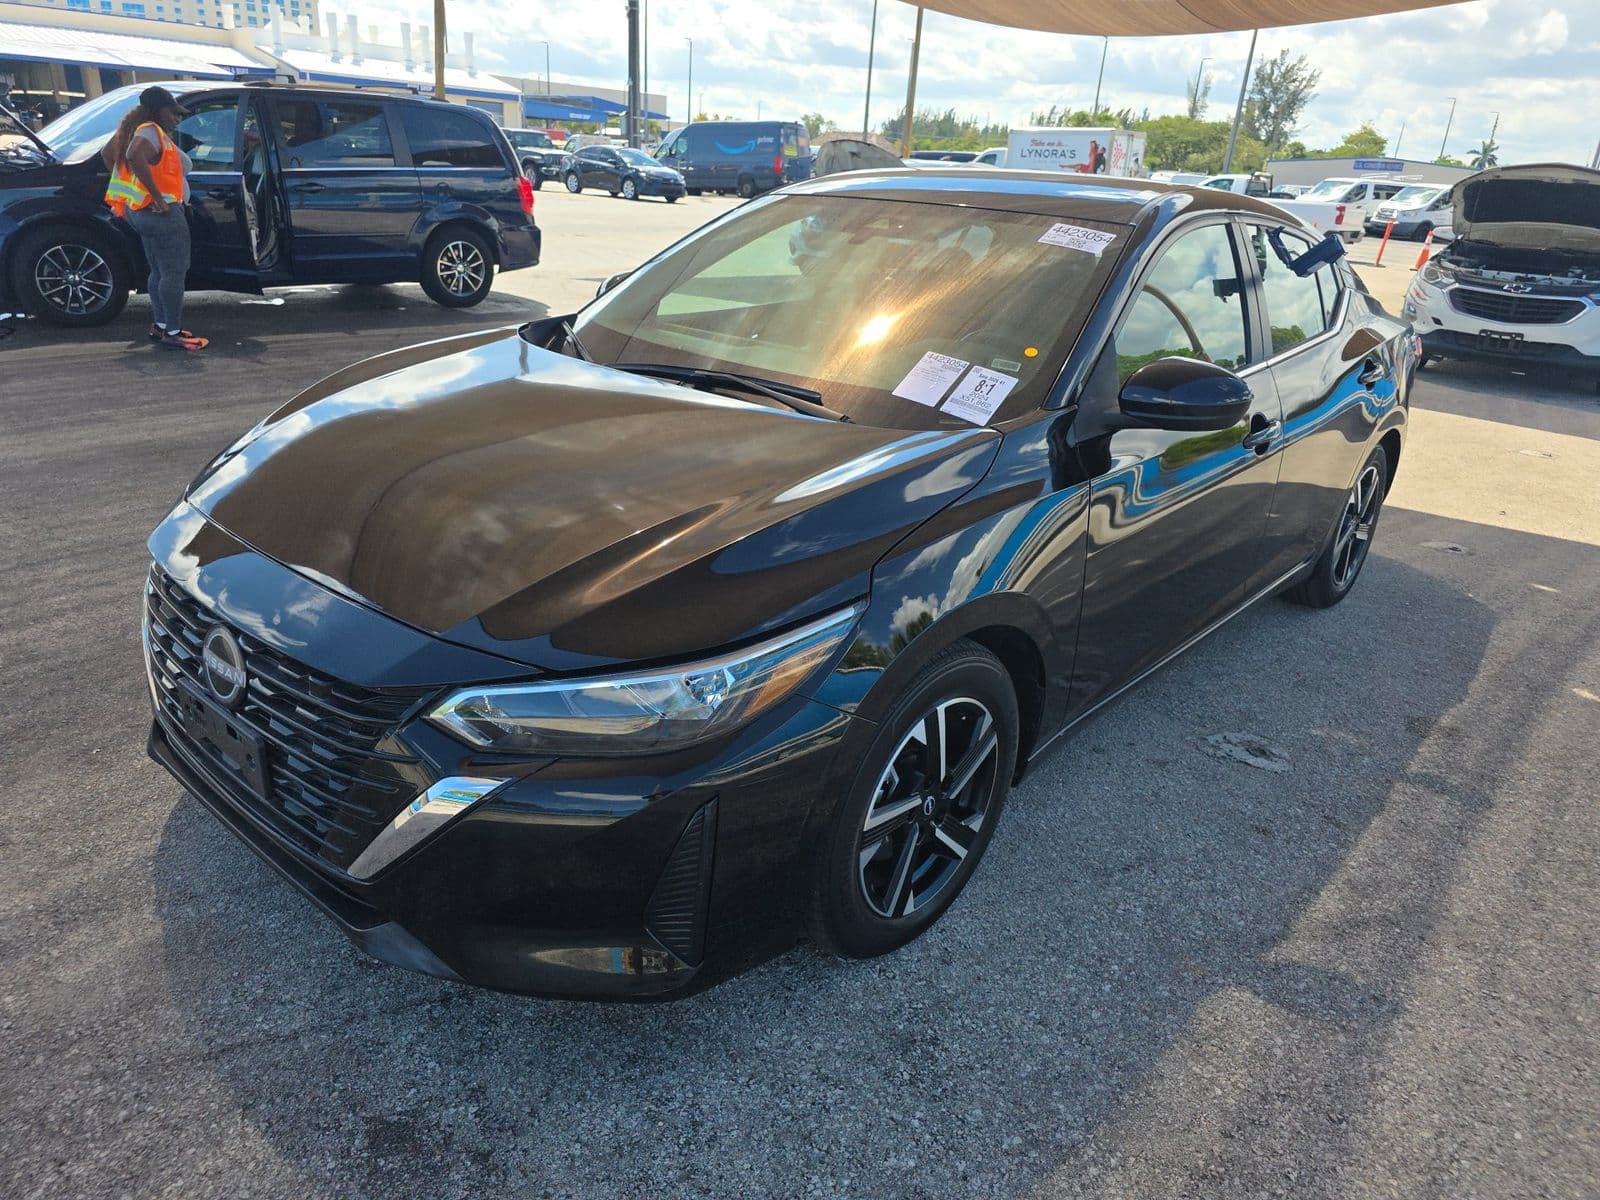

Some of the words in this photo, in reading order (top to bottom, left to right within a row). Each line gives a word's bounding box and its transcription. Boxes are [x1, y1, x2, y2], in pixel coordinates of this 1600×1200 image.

[1020, 148, 1077, 159] LYNORA'S
[1053, 225, 1113, 243] 4423054
[927, 352, 968, 369] 4423054
[974, 379, 996, 396] 8:1
